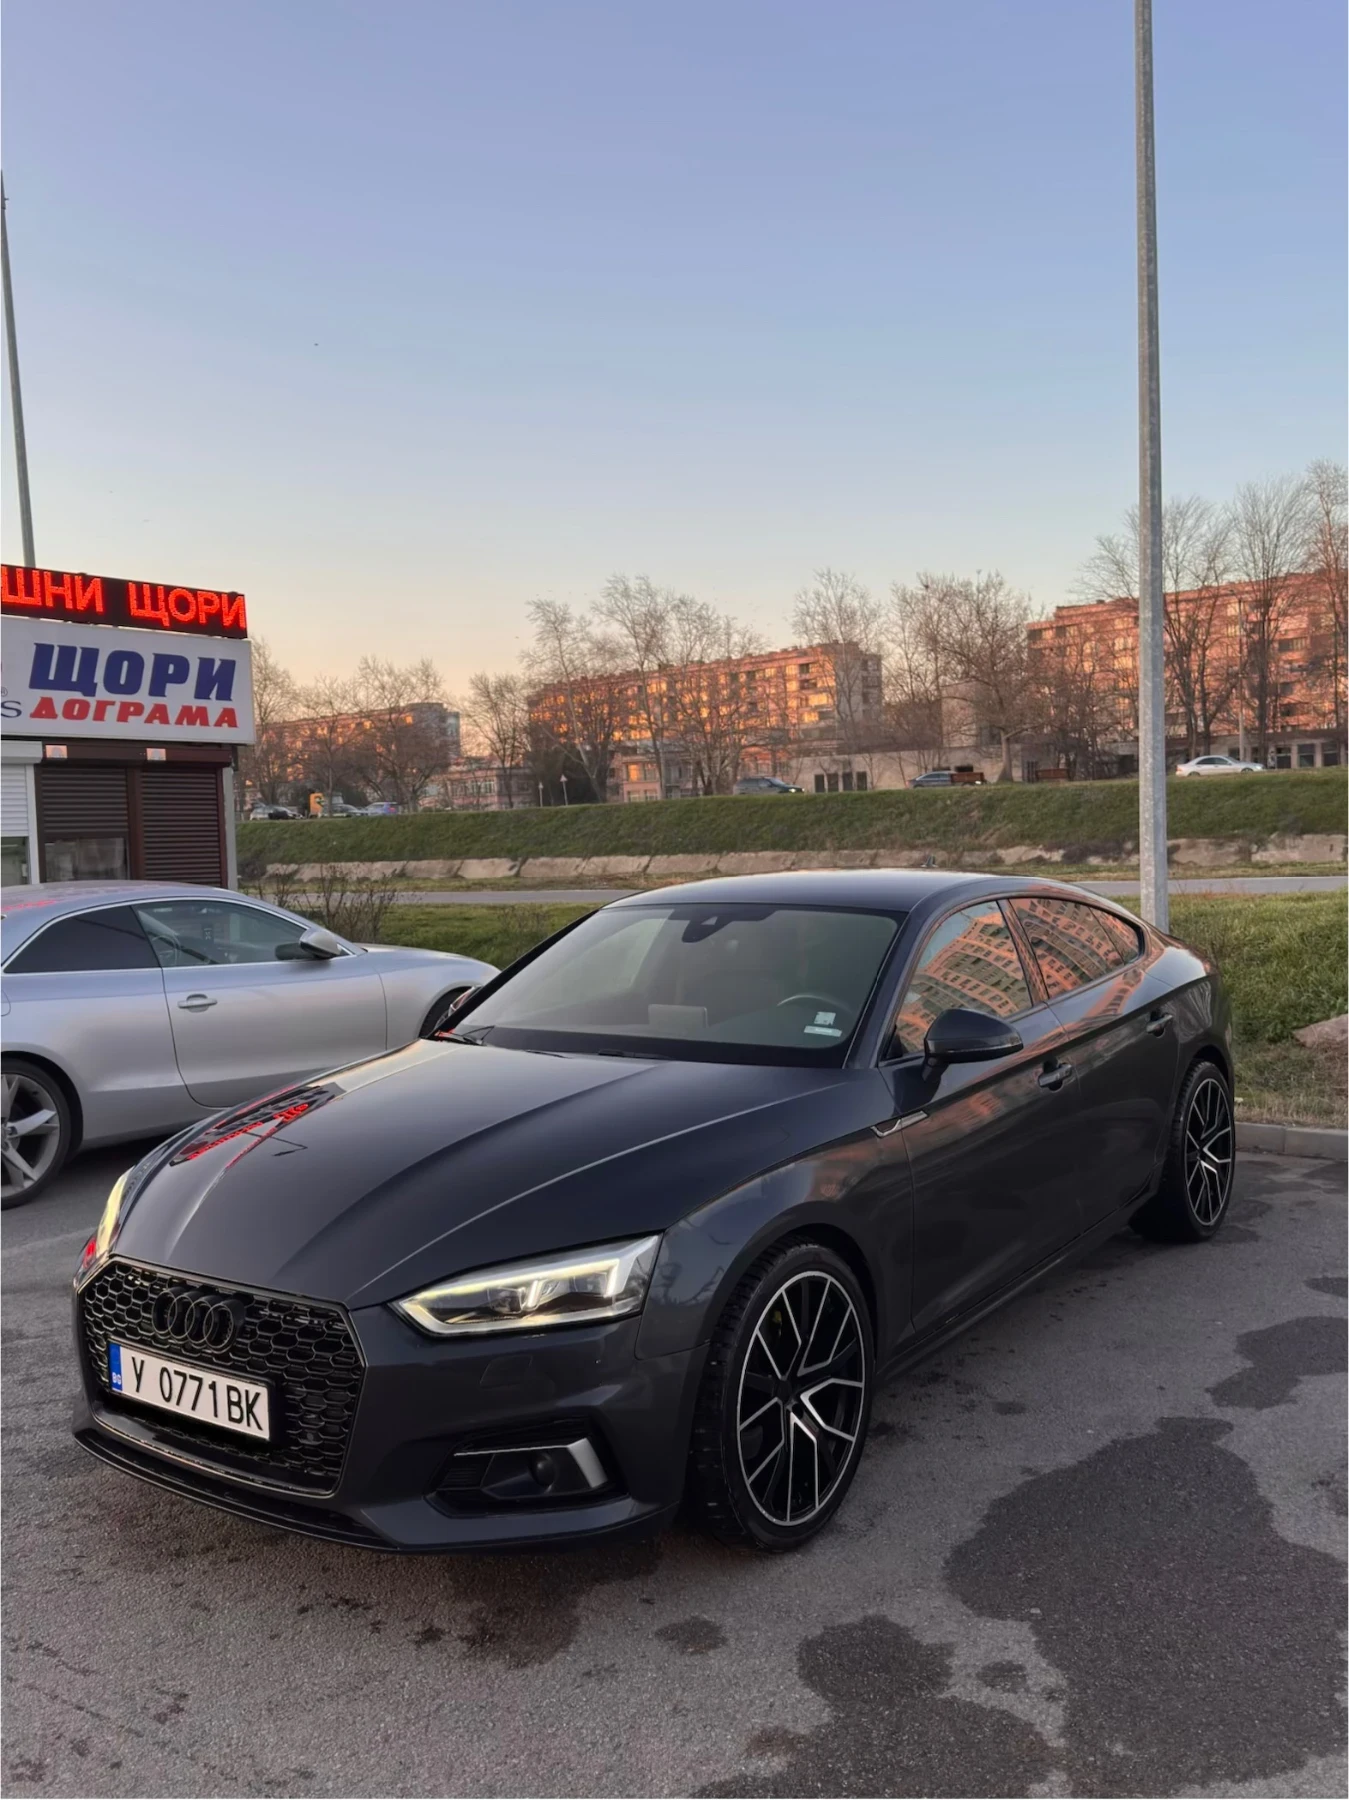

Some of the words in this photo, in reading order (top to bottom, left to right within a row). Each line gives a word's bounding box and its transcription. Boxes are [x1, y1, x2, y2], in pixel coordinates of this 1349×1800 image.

[128, 581, 246, 629] ЩОРИ
[29, 642, 236, 701] ЩОРИ
[29, 696, 239, 728] ДОГРАМА
